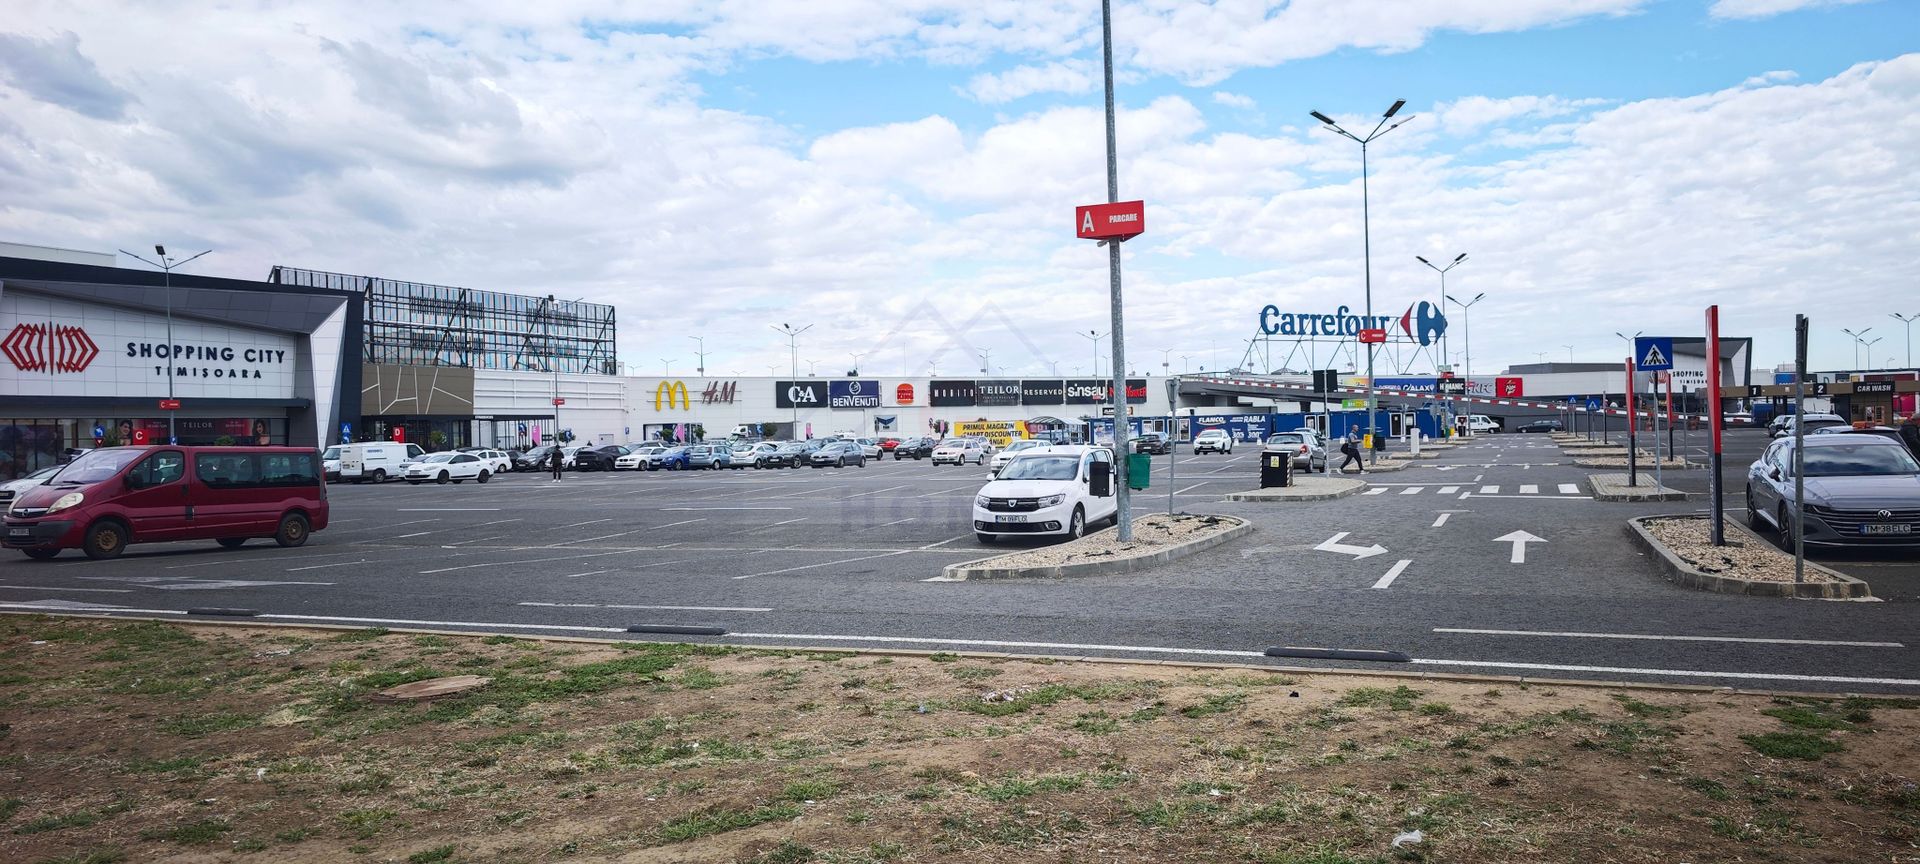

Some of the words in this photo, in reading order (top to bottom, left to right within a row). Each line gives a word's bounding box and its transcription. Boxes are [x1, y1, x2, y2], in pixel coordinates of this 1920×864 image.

[1082, 210, 1095, 233] A
[1109, 213, 1137, 224] PARCARE
[1260, 305, 1389, 336] Carrefour
[127, 342, 234, 361] SHOPPING
[244, 348, 285, 364] CITY
[1673, 370, 1704, 378] SHOPPING
[979, 385, 1019, 395] TEILOR
[1067, 383, 1106, 400] sinsay
[1439, 383, 1463, 392] HMANIC
[1817, 385, 1823, 393] 2
[702, 380, 736, 405] H&M
[788, 386, 817, 403] C&A
[832, 396, 877, 407] BENVENUTI
[1198, 416, 1225, 424] FLANCO
[1243, 415, 1266, 423] RABLA
[135, 432, 143, 440] C
[393, 427, 400, 436] D
[984, 430, 1023, 438] DISCOUNTER
[1866, 525, 1878, 533] TM
